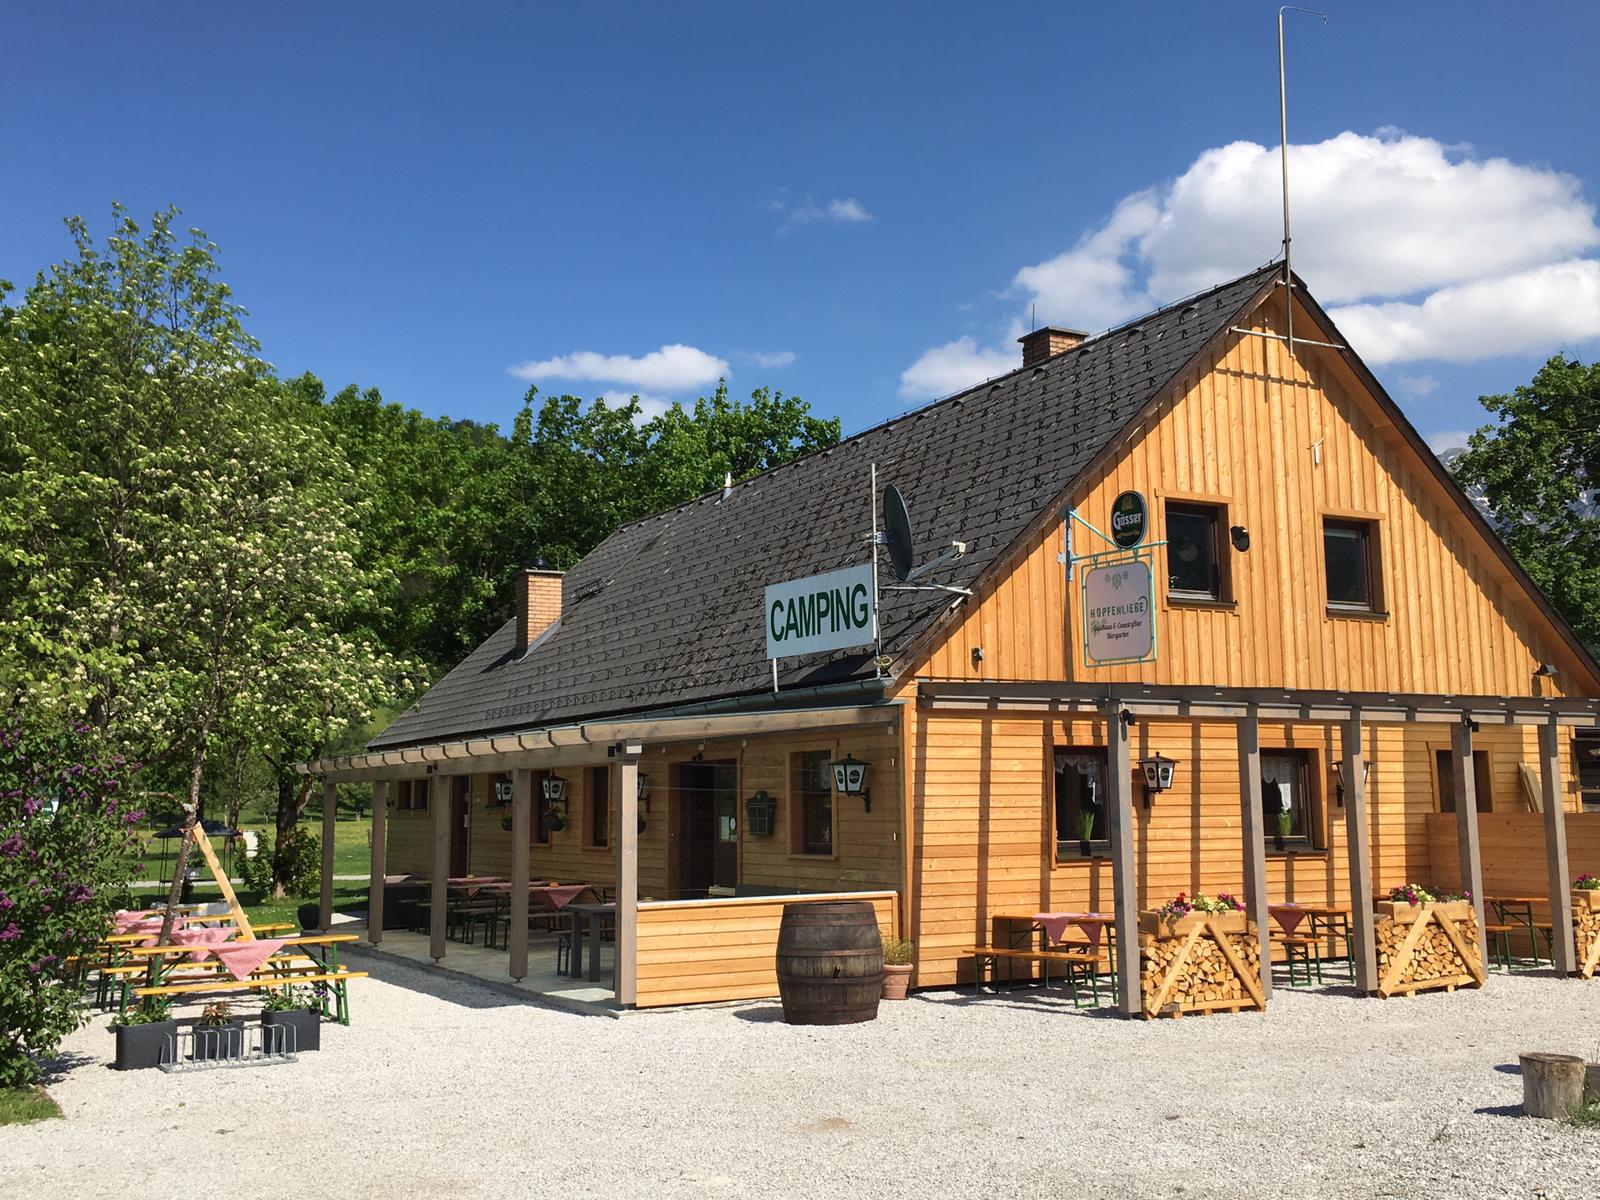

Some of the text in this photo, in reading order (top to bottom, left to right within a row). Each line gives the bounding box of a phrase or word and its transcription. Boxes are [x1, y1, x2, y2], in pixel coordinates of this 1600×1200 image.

[1113, 511, 1141, 530] Gösser
[770, 583, 869, 642] CAMPING
[1090, 601, 1144, 618] HOPFENLIEBE
